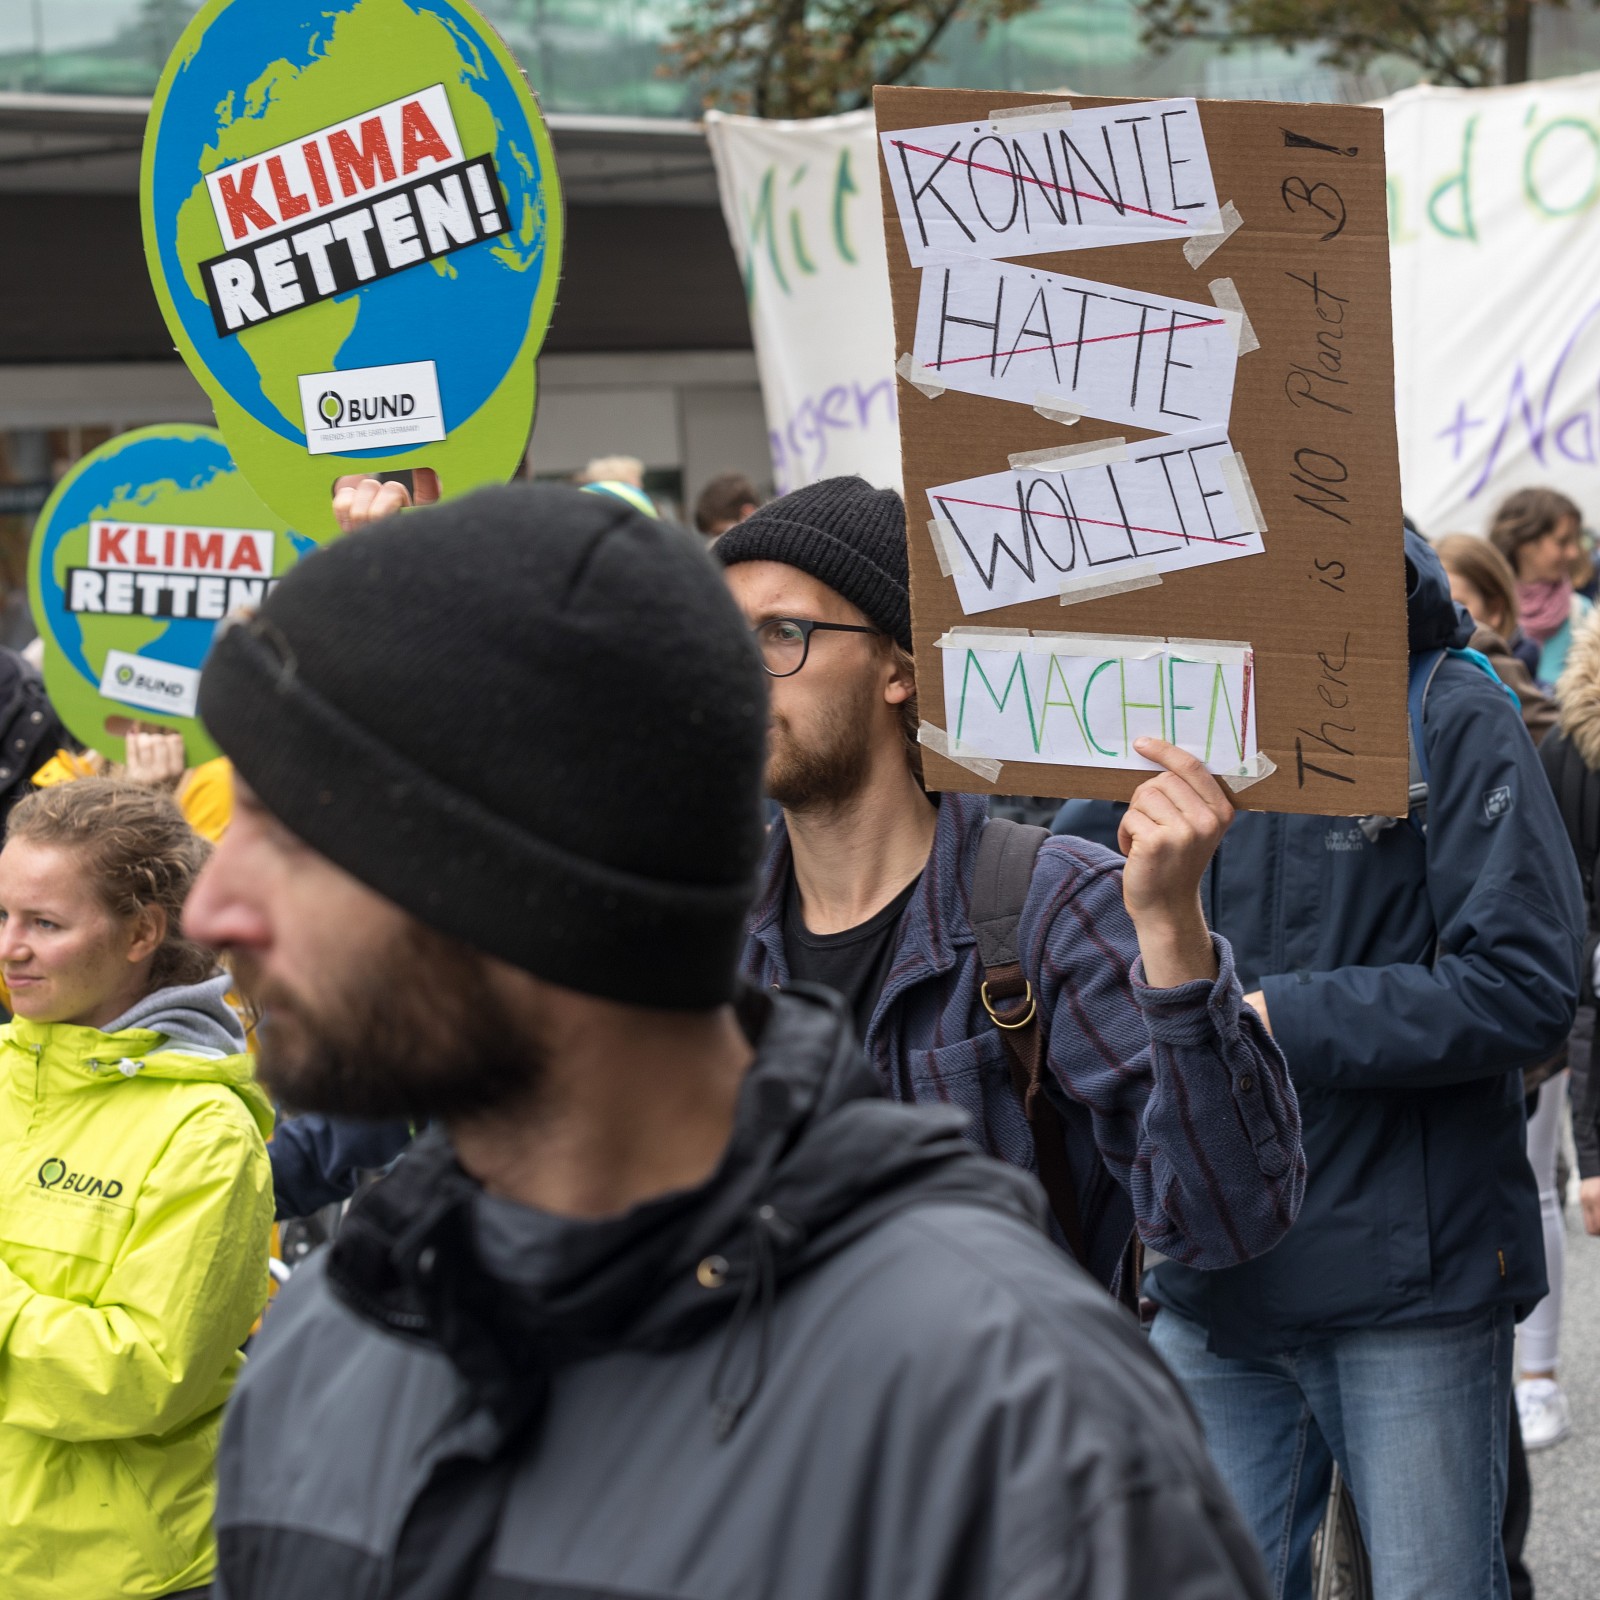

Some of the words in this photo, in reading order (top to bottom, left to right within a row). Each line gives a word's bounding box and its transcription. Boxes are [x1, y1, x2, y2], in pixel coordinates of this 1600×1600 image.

[218, 100, 453, 240] KLIMA
[896, 110, 1206, 248] KÖNNTE
[210, 163, 502, 330] RETTEN!
[937, 268, 1214, 421] HÄTTE
[1285, 272, 1353, 414] Planet
[349, 393, 415, 422] BUND
[937, 440, 1254, 591] WOLLTE
[1290, 448, 1351, 525] NO
[70, 569, 280, 619] RETTEN
[98, 527, 263, 572] KLIMA
[1308, 558, 1345, 592] is
[134, 673, 184, 697] BUND
[1296, 632, 1355, 789] There
[62, 1172, 123, 1199] BUND
